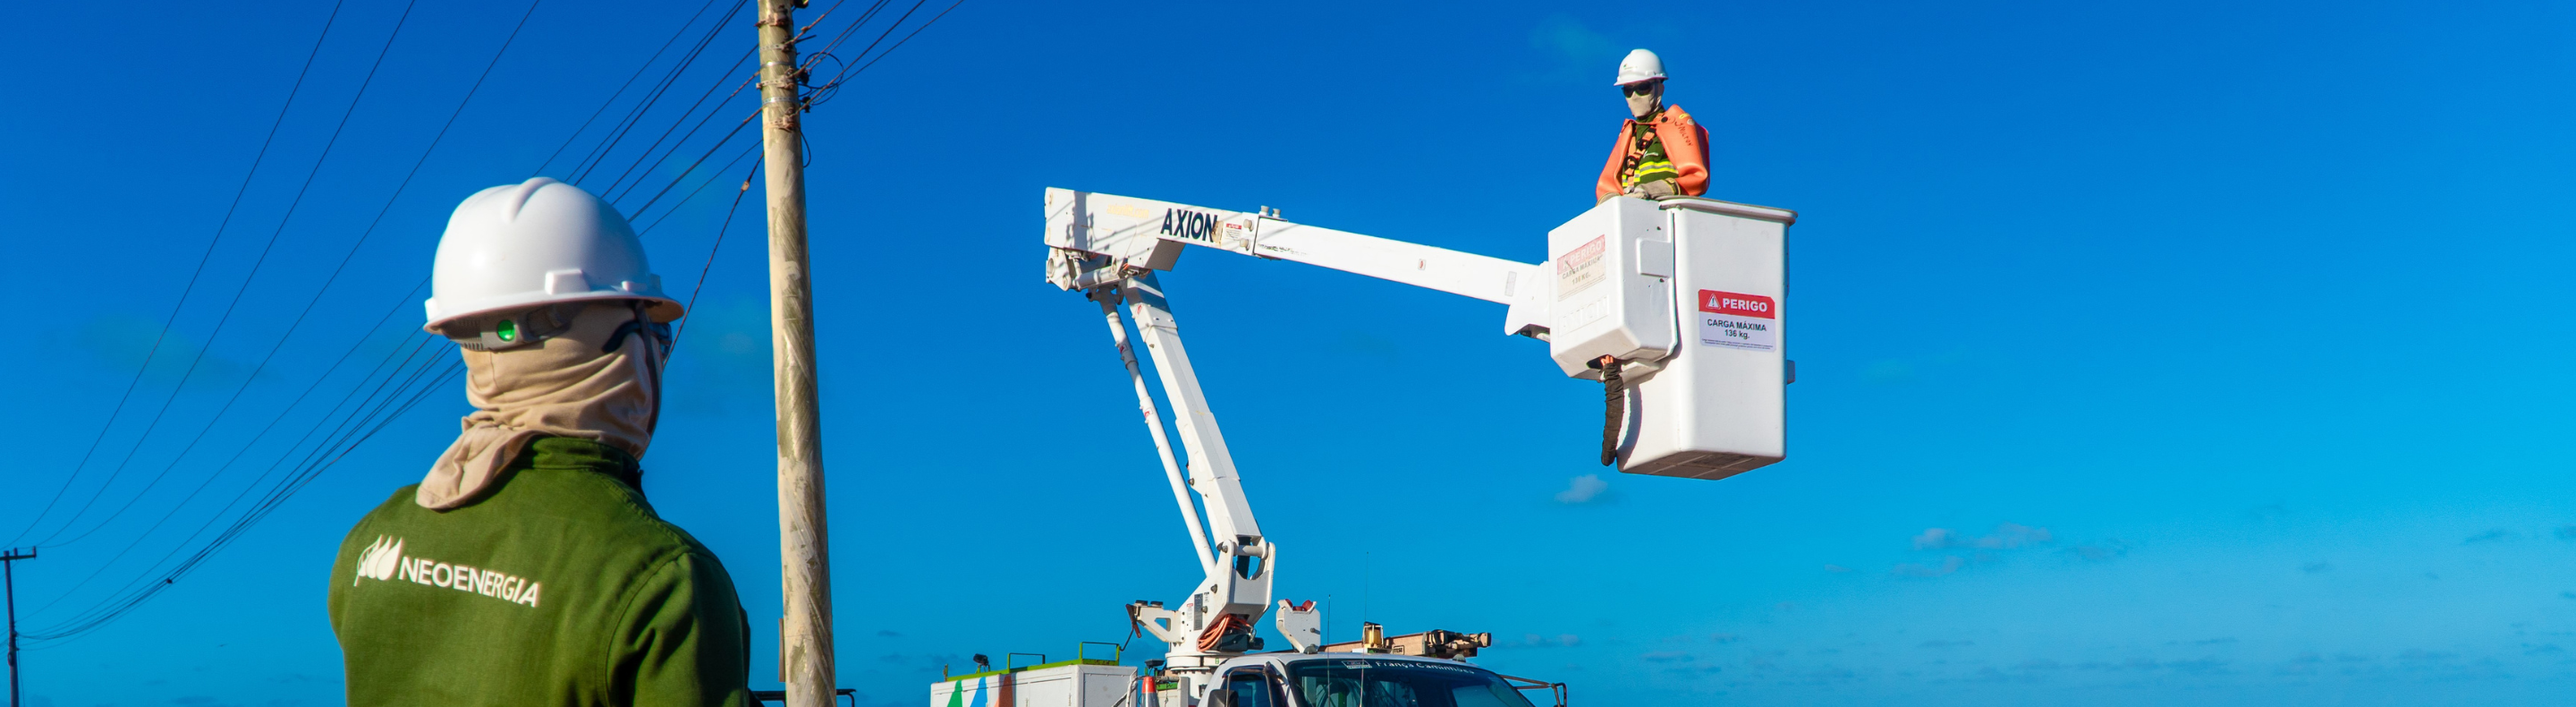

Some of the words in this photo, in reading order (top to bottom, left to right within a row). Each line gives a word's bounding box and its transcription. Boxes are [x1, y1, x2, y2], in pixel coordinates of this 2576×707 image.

[1160, 208, 1218, 243] AXION
[1571, 240, 1602, 264] PERIGO
[1562, 267, 1580, 279] CARGA
[1723, 298, 1767, 312] PERIGO
[1707, 319, 1735, 329] CARGA
[1736, 320, 1767, 332] MÁXIMA
[1724, 329, 1737, 337] 136
[1738, 330, 1750, 340] kg.
[398, 556, 540, 608] NEOENERGIA
